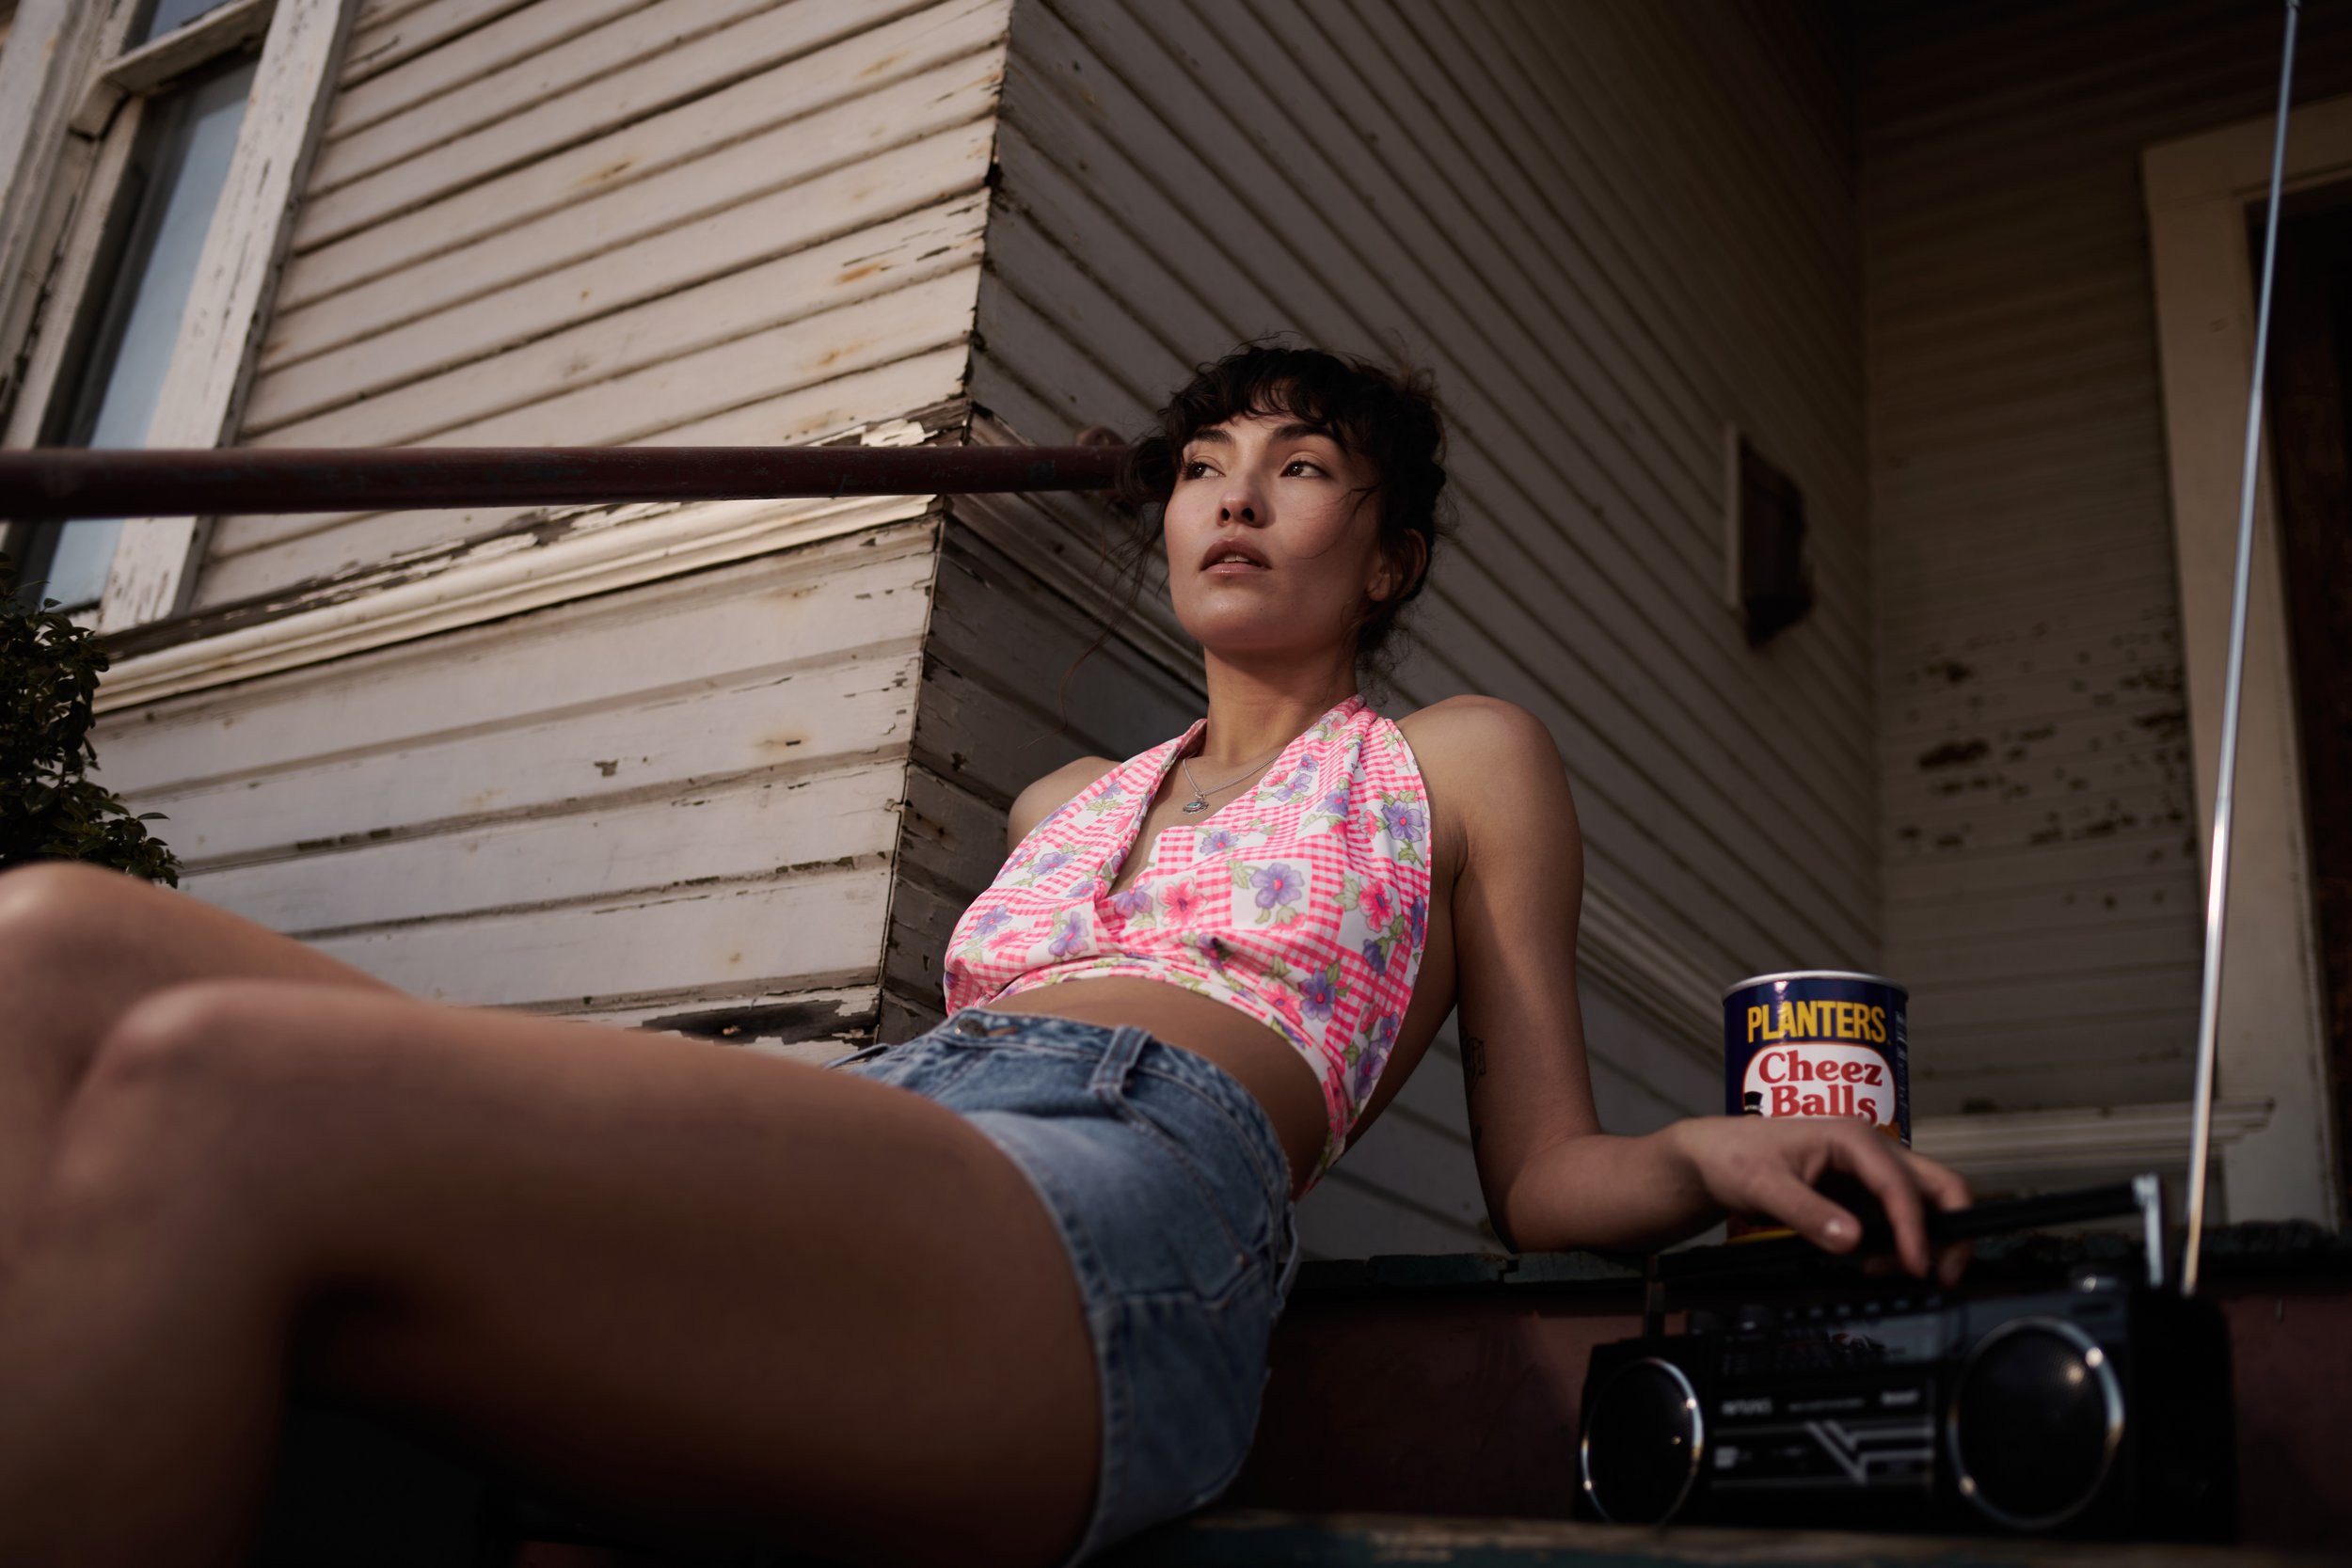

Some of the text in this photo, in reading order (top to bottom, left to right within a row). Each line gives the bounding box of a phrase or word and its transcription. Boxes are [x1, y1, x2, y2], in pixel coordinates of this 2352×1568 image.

[1747, 1000, 1887, 1043] PLANTERS
[1758, 1049, 1883, 1086] Cheez
[1770, 1084, 1878, 1126] Balls
